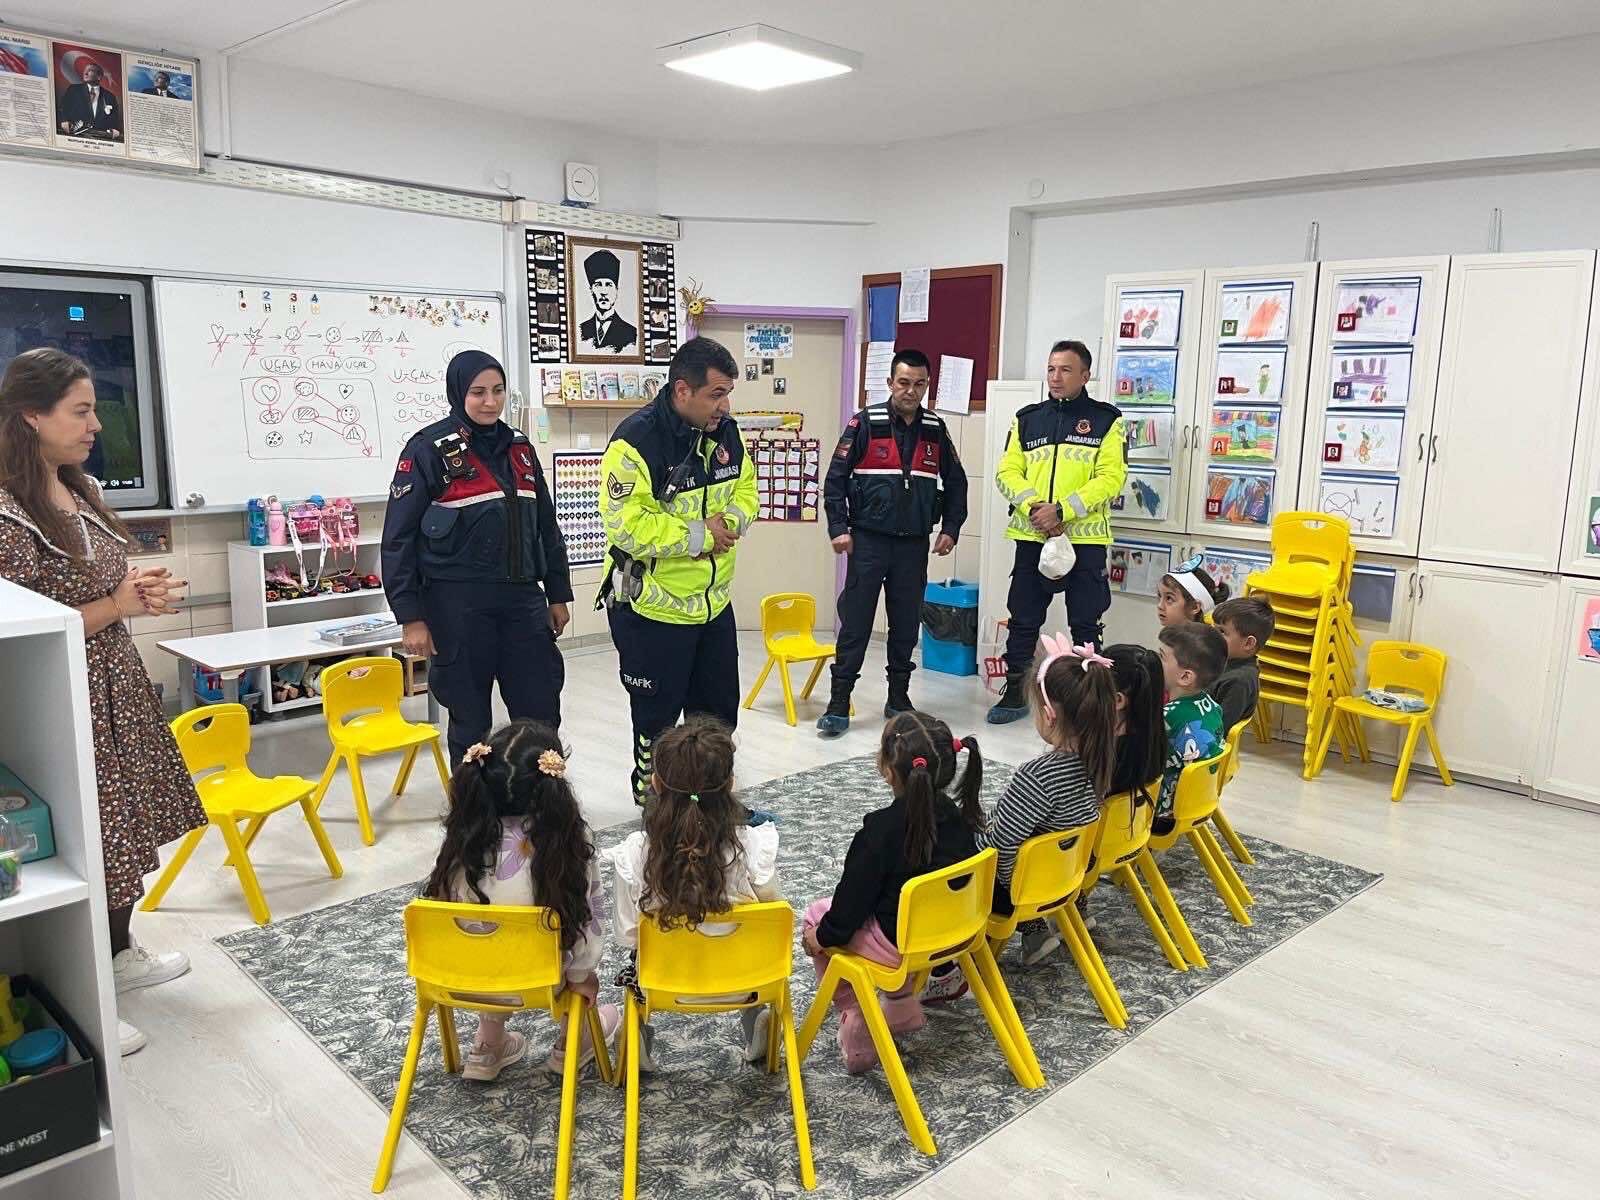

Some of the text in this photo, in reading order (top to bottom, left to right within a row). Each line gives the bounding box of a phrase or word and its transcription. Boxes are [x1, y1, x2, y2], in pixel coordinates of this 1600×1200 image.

[238, 289, 319, 303] 1 2 3 4
[311, 360, 341, 370] HAVA
[17, 1129, 48, 1148] WEST
